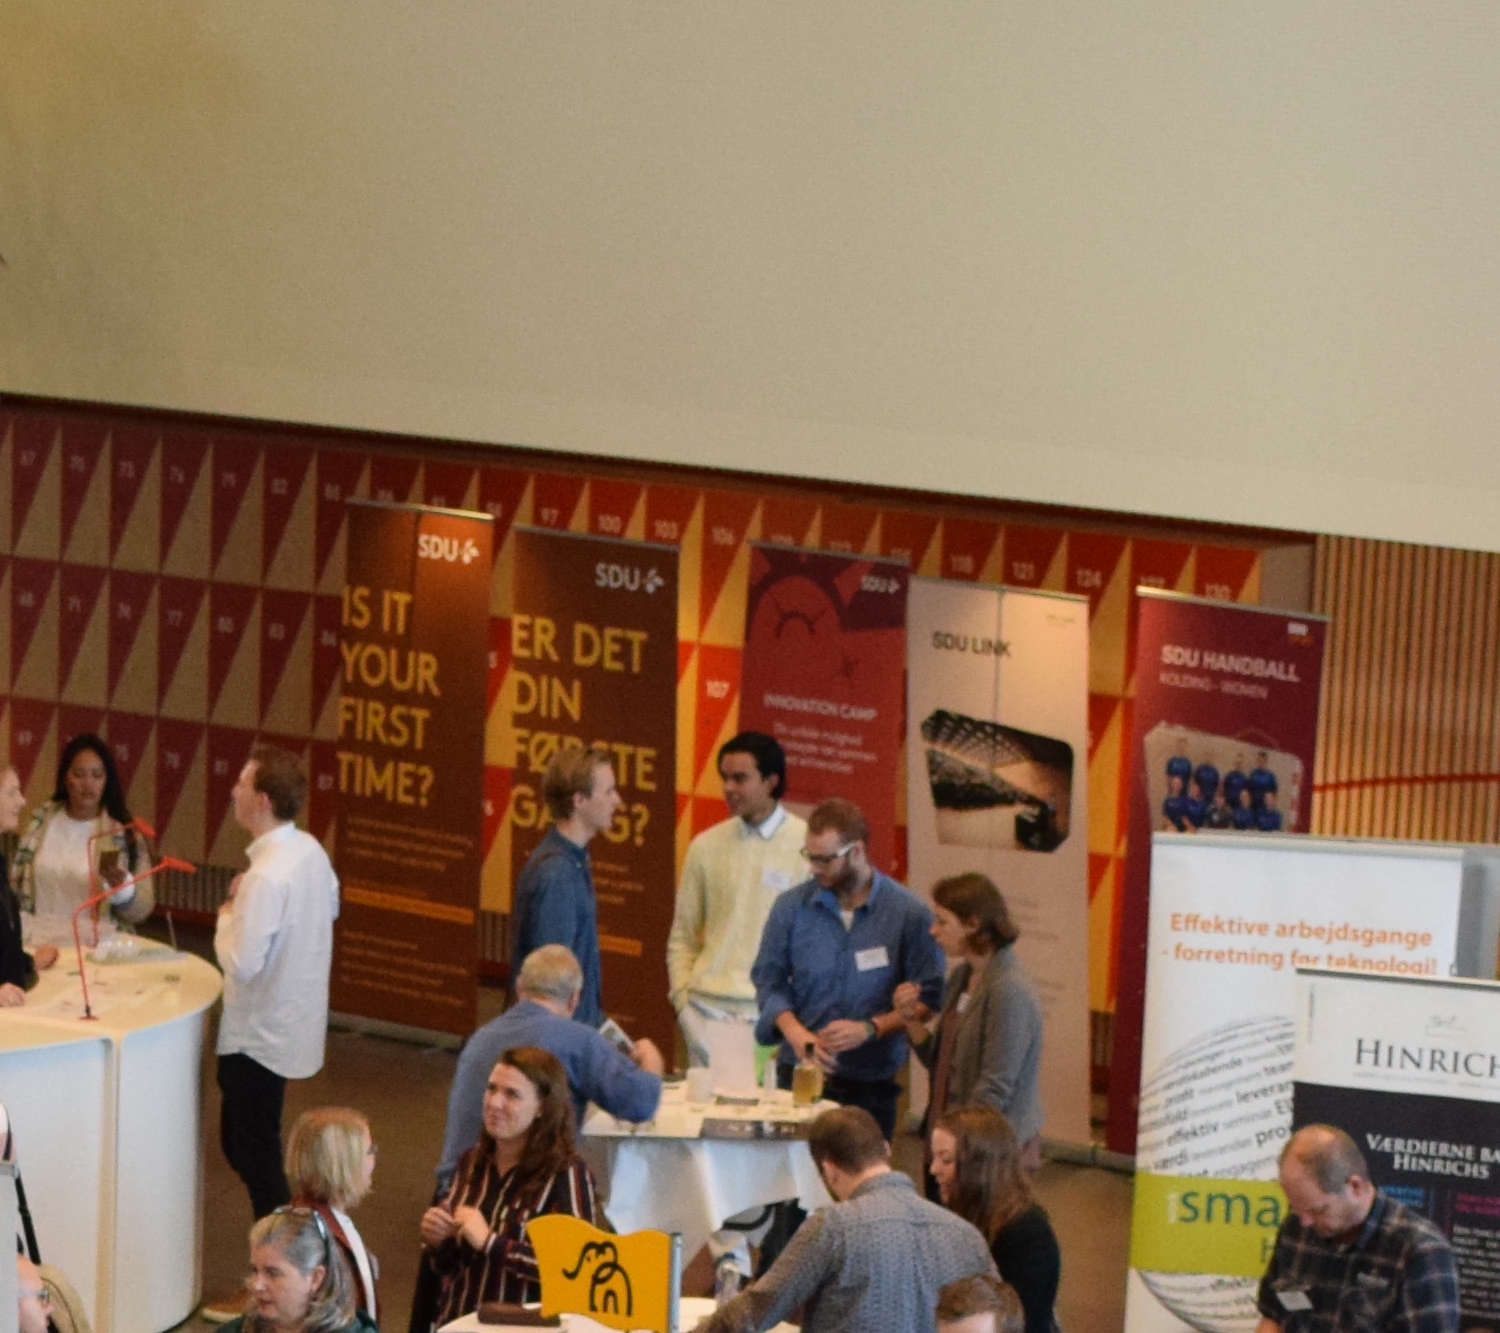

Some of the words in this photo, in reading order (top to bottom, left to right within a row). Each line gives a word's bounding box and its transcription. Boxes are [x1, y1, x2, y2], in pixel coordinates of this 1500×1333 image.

[418, 533, 459, 562] SDU
[594, 562, 641, 592] SDU
[340, 584, 372, 629] IS
[381, 590, 413, 636] IT
[510, 612, 560, 664] ER
[572, 620, 649, 675] DET
[931, 629, 970, 653] SDU
[971, 635, 1013, 659] LINK
[1160, 643, 1200, 669] SDU
[1201, 650, 1301, 684] HANDBALL
[340, 641, 442, 698] YOUR
[513, 669, 583, 724] DIN
[336, 694, 431, 751] FIRST
[336, 750, 436, 807] TIME?
[1169, 911, 1270, 937] Effektive
[1274, 919, 1434, 951] arbejdsgange
[1173, 941, 1285, 970] forretning
[1366, 1132, 1476, 1161] VÆRDIERNE
[1393, 1152, 1491, 1181] HINRICHS
